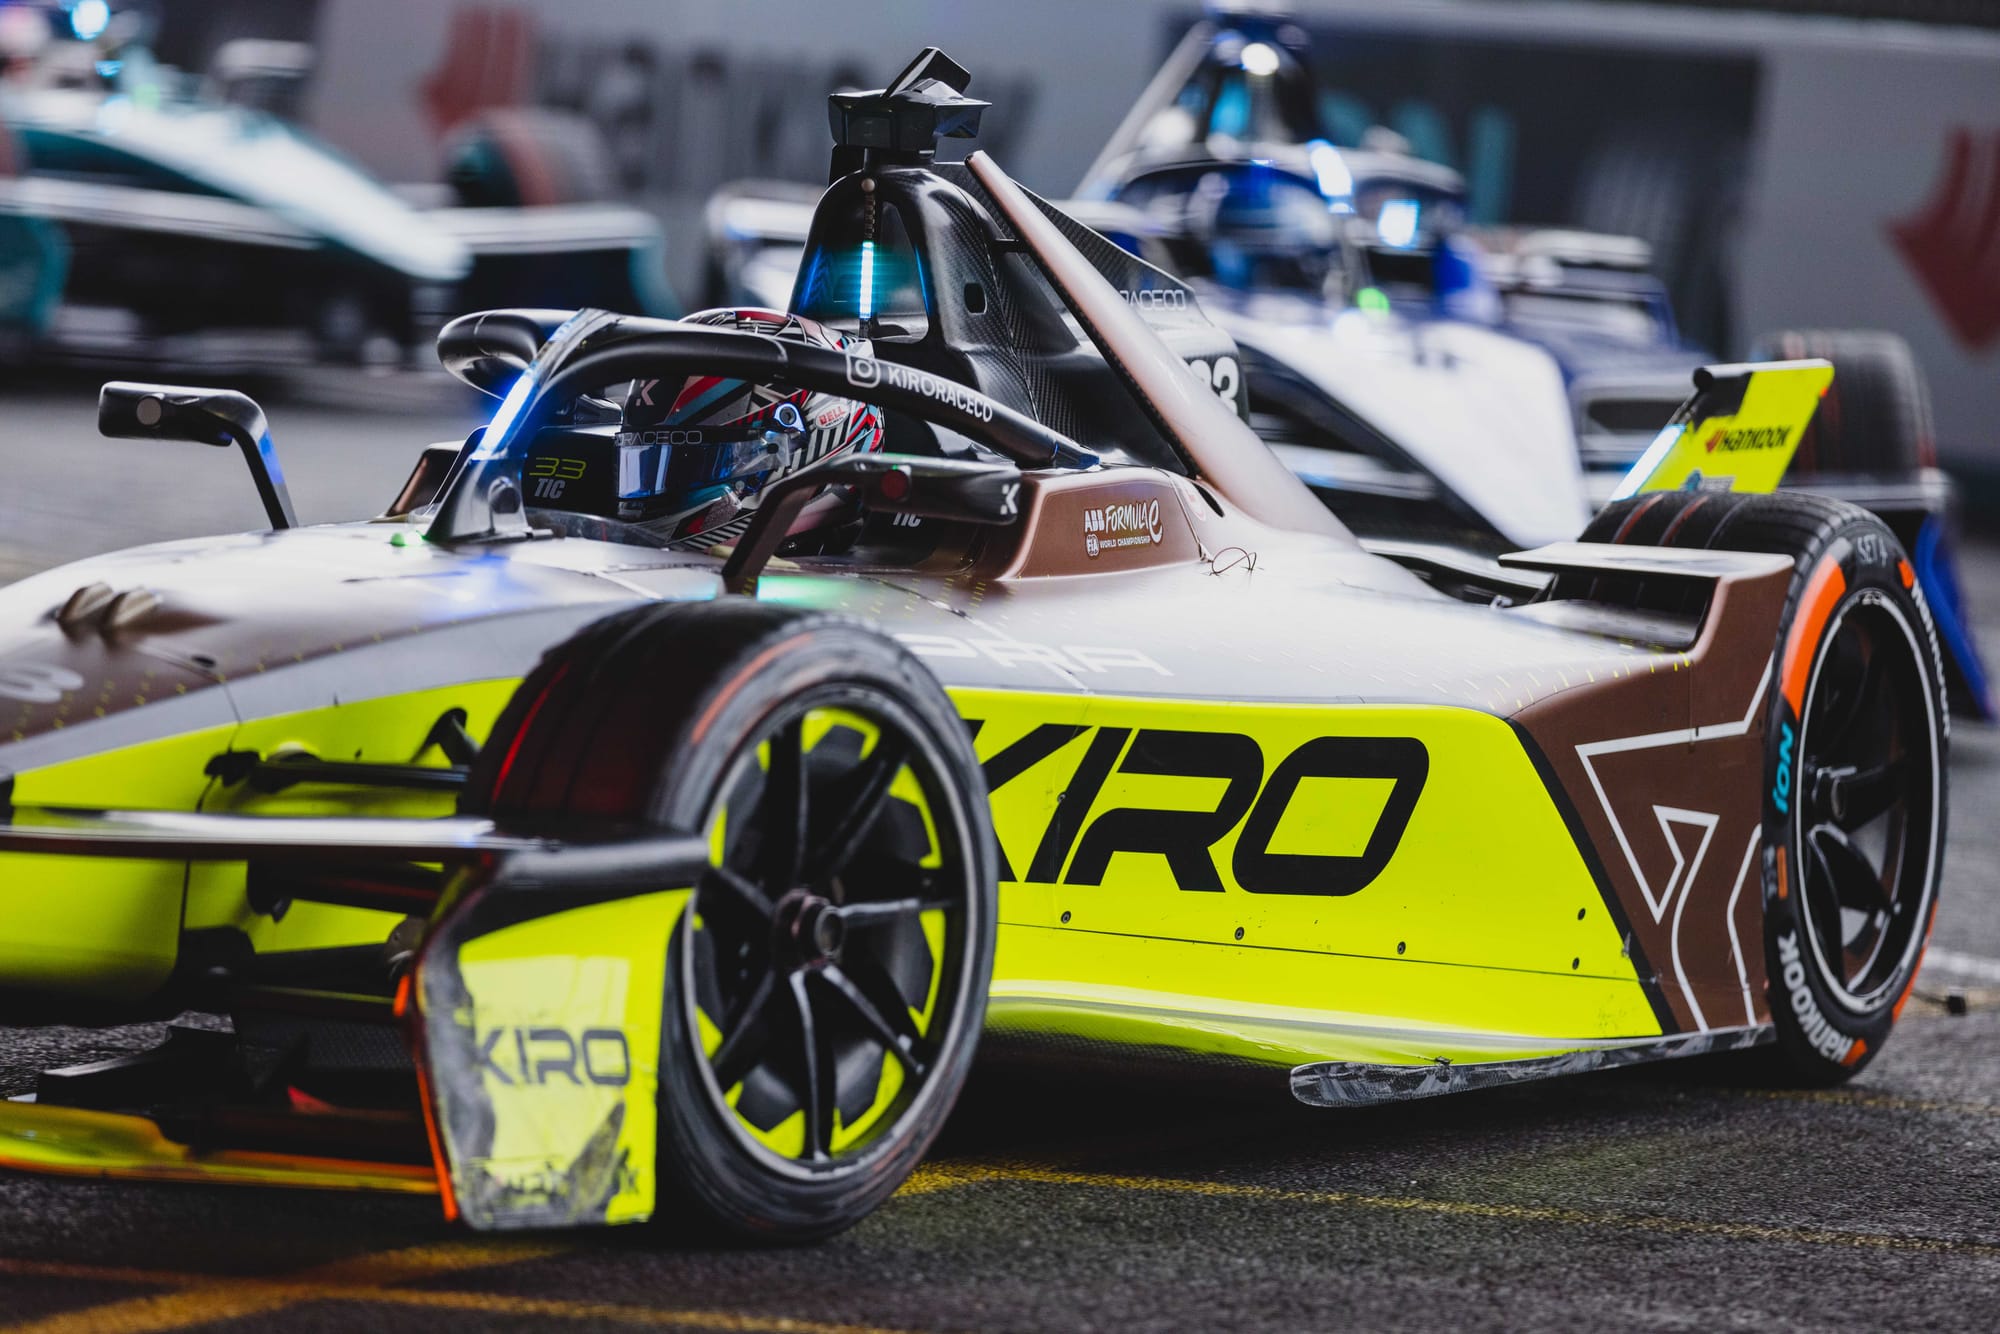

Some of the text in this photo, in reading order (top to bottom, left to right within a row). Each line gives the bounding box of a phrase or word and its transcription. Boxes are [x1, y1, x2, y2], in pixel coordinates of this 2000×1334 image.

[888, 366, 993, 423] KIRORACECO
[529, 456, 587, 479] 33
[534, 478, 566, 499] TIC
[1085, 509, 1105, 533] ABB
[1105, 502, 1149, 533] FORMULA
[965, 719, 1430, 897] KIRO
[474, 1028, 631, 1087] KIRO
